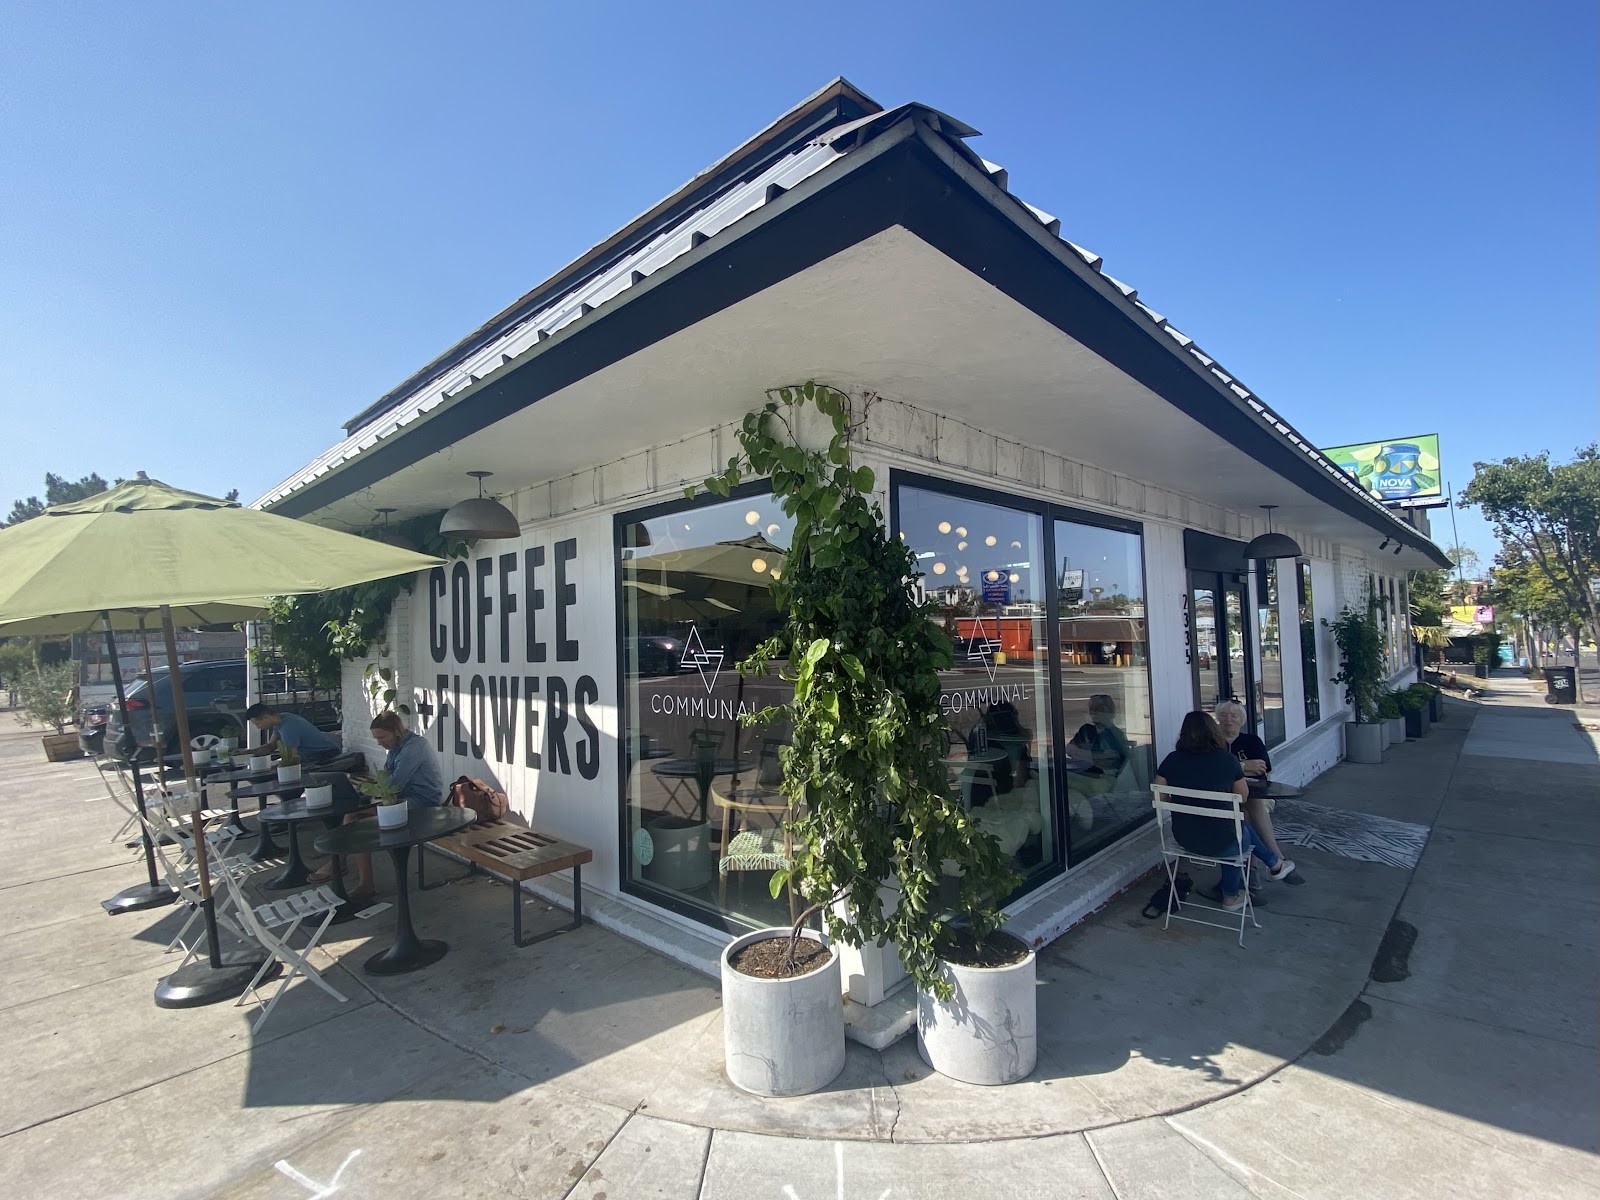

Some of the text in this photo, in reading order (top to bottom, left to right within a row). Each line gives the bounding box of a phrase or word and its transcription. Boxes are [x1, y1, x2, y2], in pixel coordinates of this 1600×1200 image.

[1380, 478, 1412, 487] NOVA
[429, 537, 579, 664] COFFEE
[1182, 594, 1191, 665] 2335
[939, 682, 1030, 716] COMMUNAL
